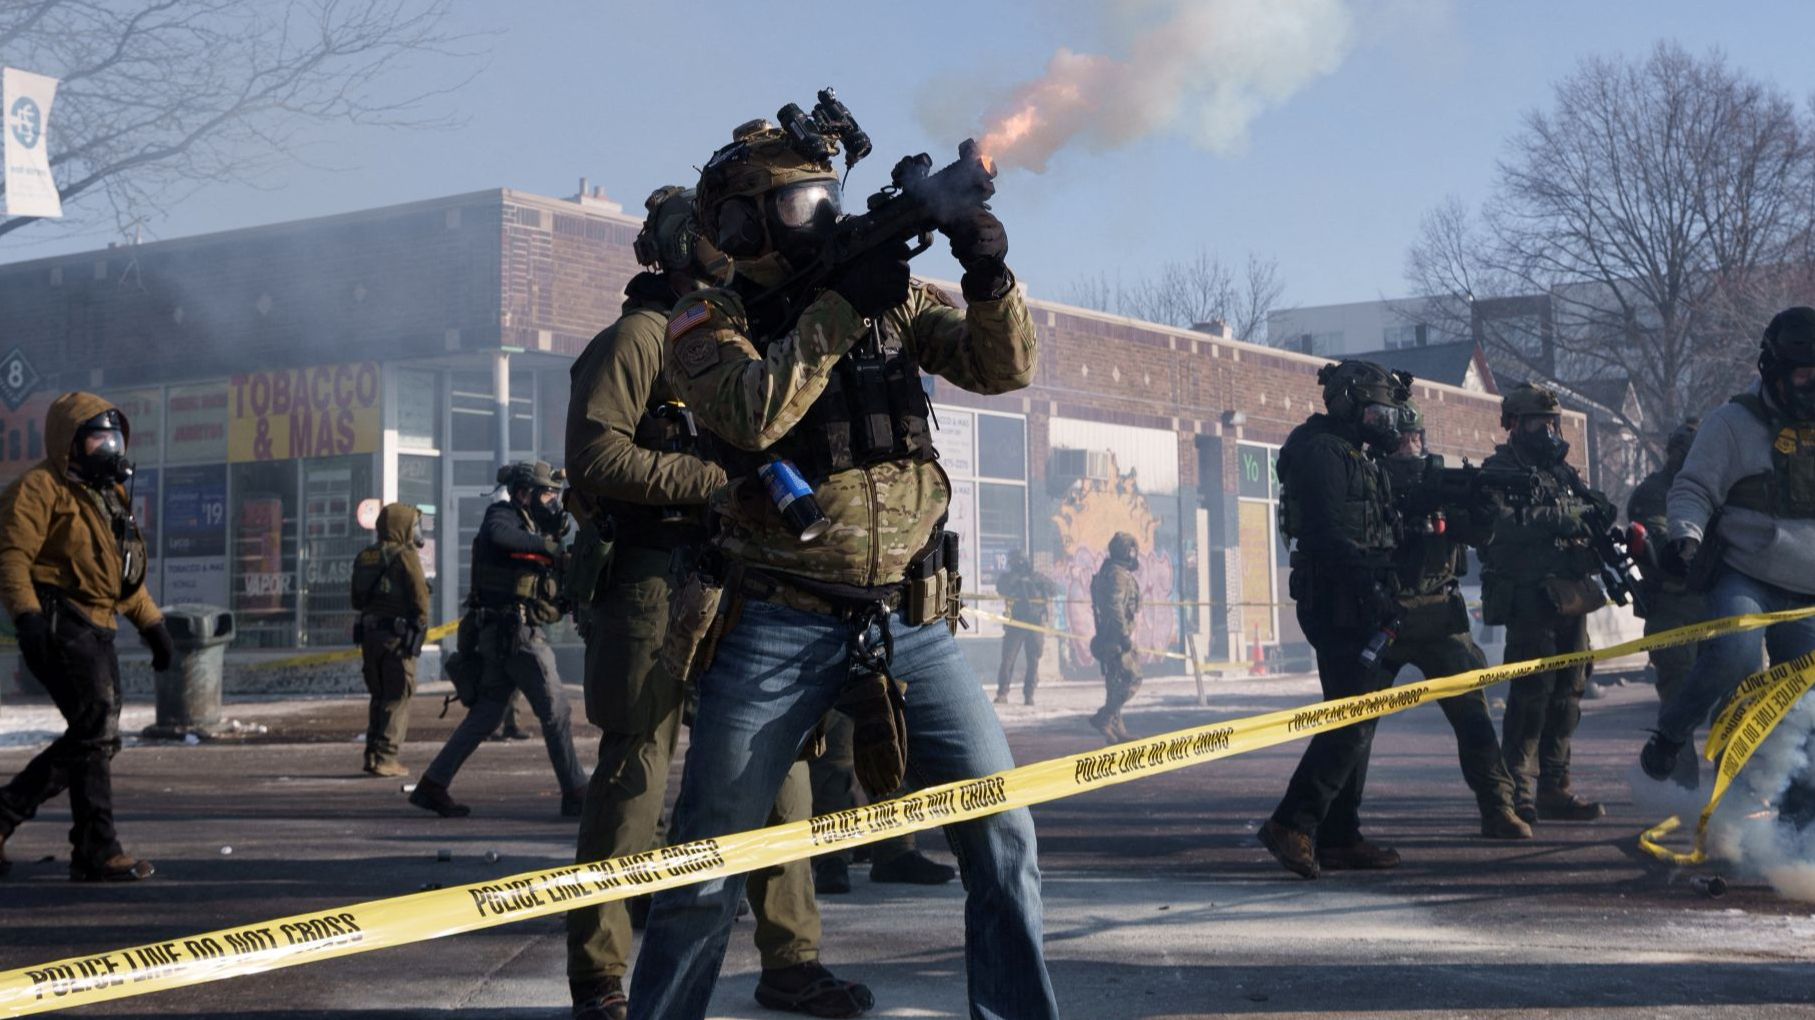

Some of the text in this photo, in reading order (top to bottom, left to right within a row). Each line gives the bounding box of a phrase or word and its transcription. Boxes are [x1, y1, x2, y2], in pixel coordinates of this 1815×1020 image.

[7, 359, 24, 389] 8
[231, 362, 377, 418] TOBACCO
[253, 417, 273, 461] &
[289, 409, 355, 458] MAS
[1243, 453, 1259, 482] Yo
[245, 573, 291, 597] VAPOR
[1740, 675, 1770, 694] LINE
[1075, 752, 1118, 785] POLICE
[1118, 745, 1147, 774] LINE
[1147, 741, 1166, 767] DO
[1167, 735, 1194, 762] NOT
[808, 777, 1007, 846] POLICE LINE DO NOT CROSS
[468, 881, 545, 917] POLICE
[540, 867, 593, 902] LINE
[588, 861, 621, 890] DO
[619, 853, 663, 885] NOT
[25, 913, 363, 999] POLICE LINE DO NOT CROSS
